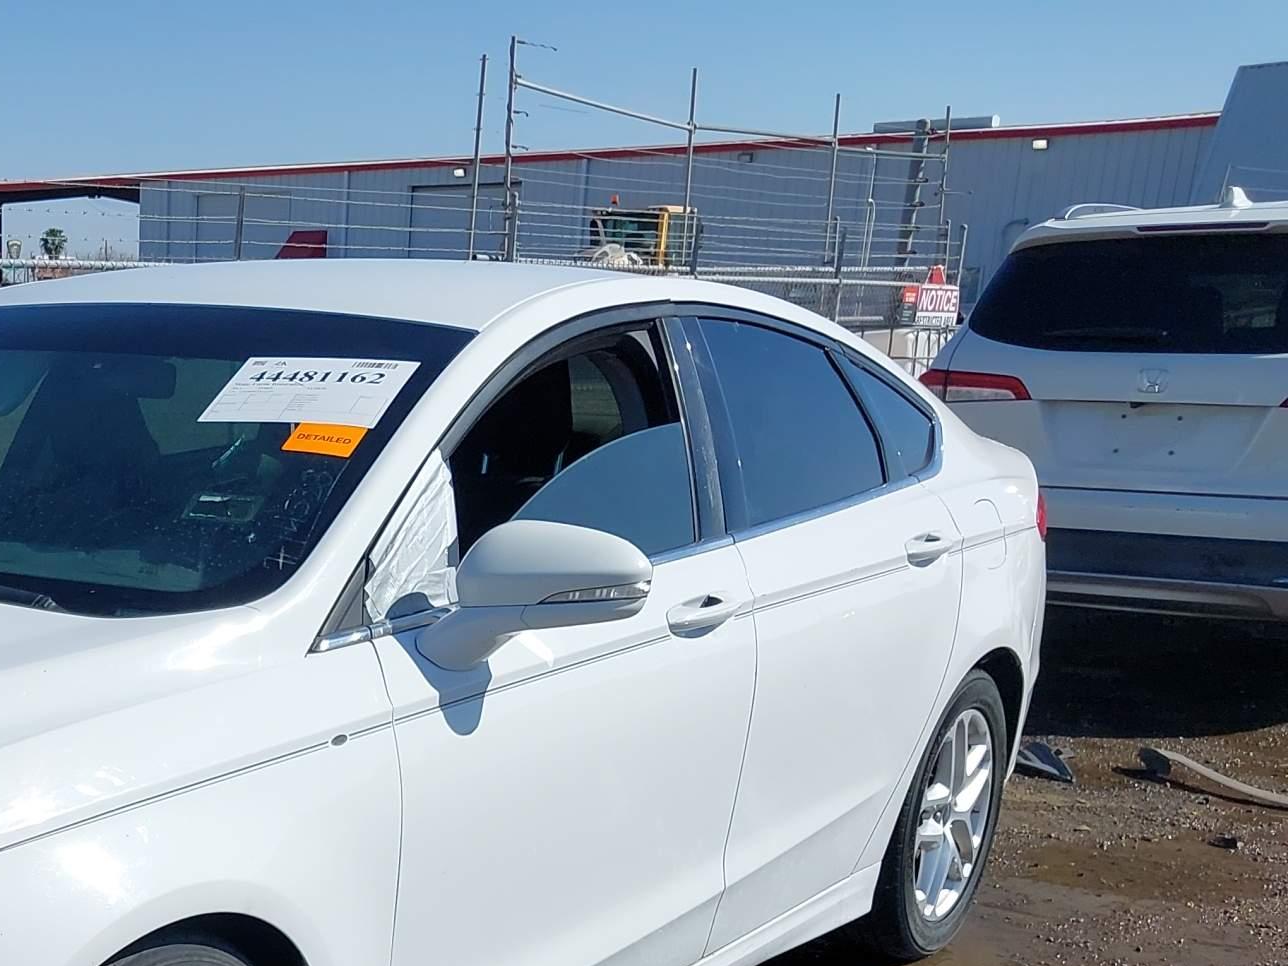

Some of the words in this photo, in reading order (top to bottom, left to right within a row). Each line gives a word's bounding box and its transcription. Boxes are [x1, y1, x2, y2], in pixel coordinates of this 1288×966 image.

[918, 289, 958, 311] NOTICE
[249, 370, 386, 385] 44481162
[296, 432, 352, 445] DETAILED
